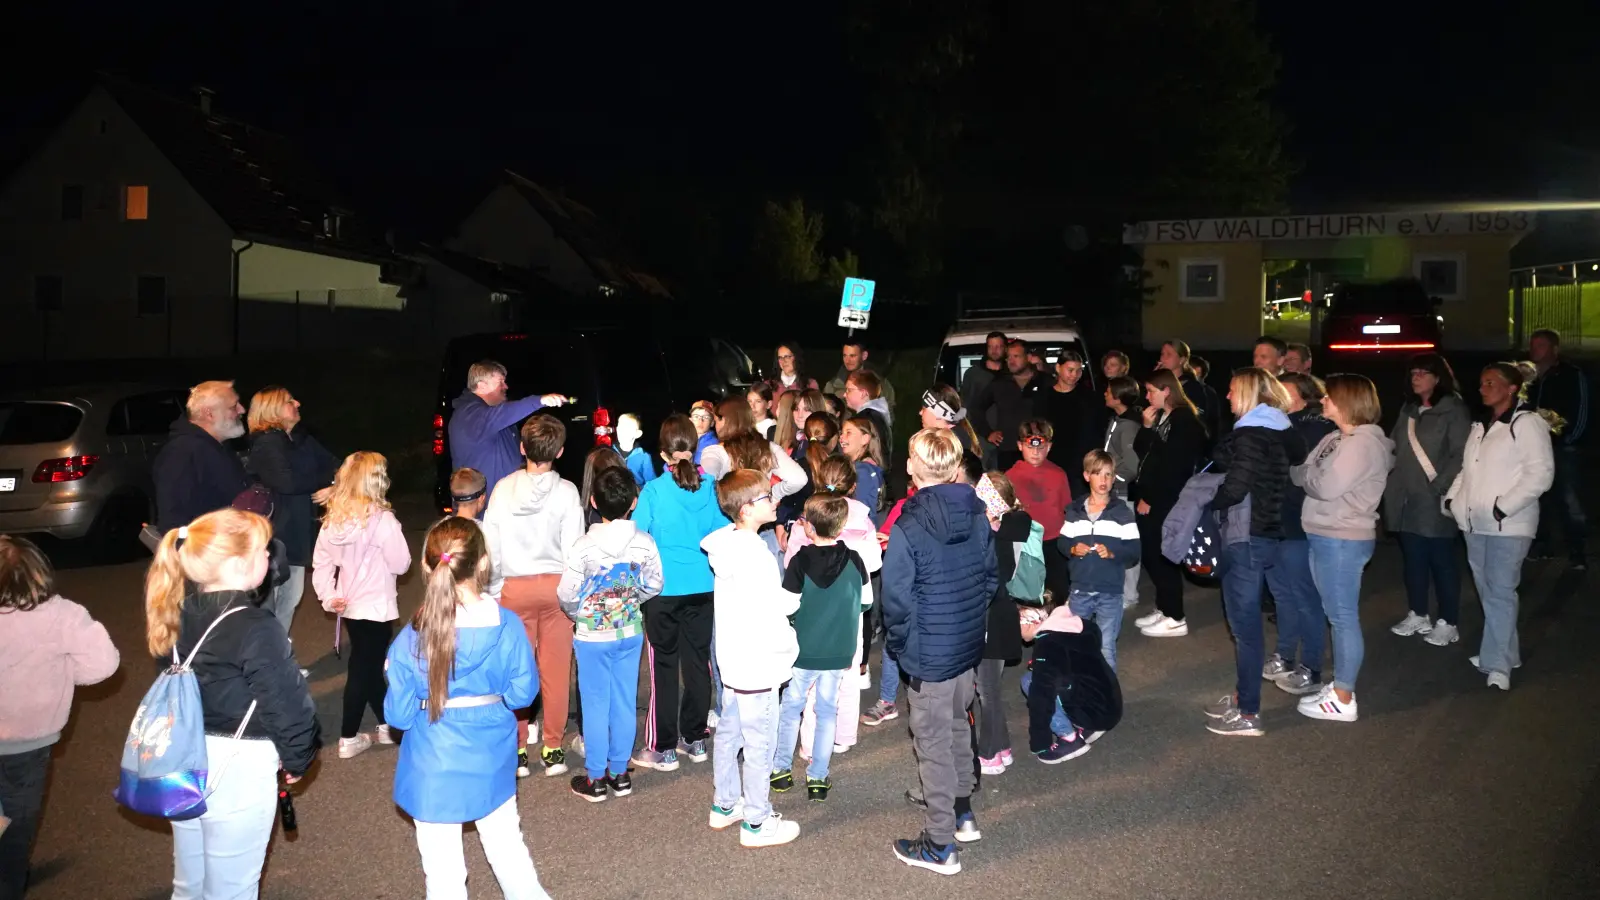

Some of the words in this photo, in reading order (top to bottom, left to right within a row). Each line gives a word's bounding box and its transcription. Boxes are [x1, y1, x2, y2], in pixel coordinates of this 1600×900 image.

[1157, 219, 1203, 241] FSV
[1214, 215, 1386, 240] WALDTHURN
[849, 283, 866, 309] P
